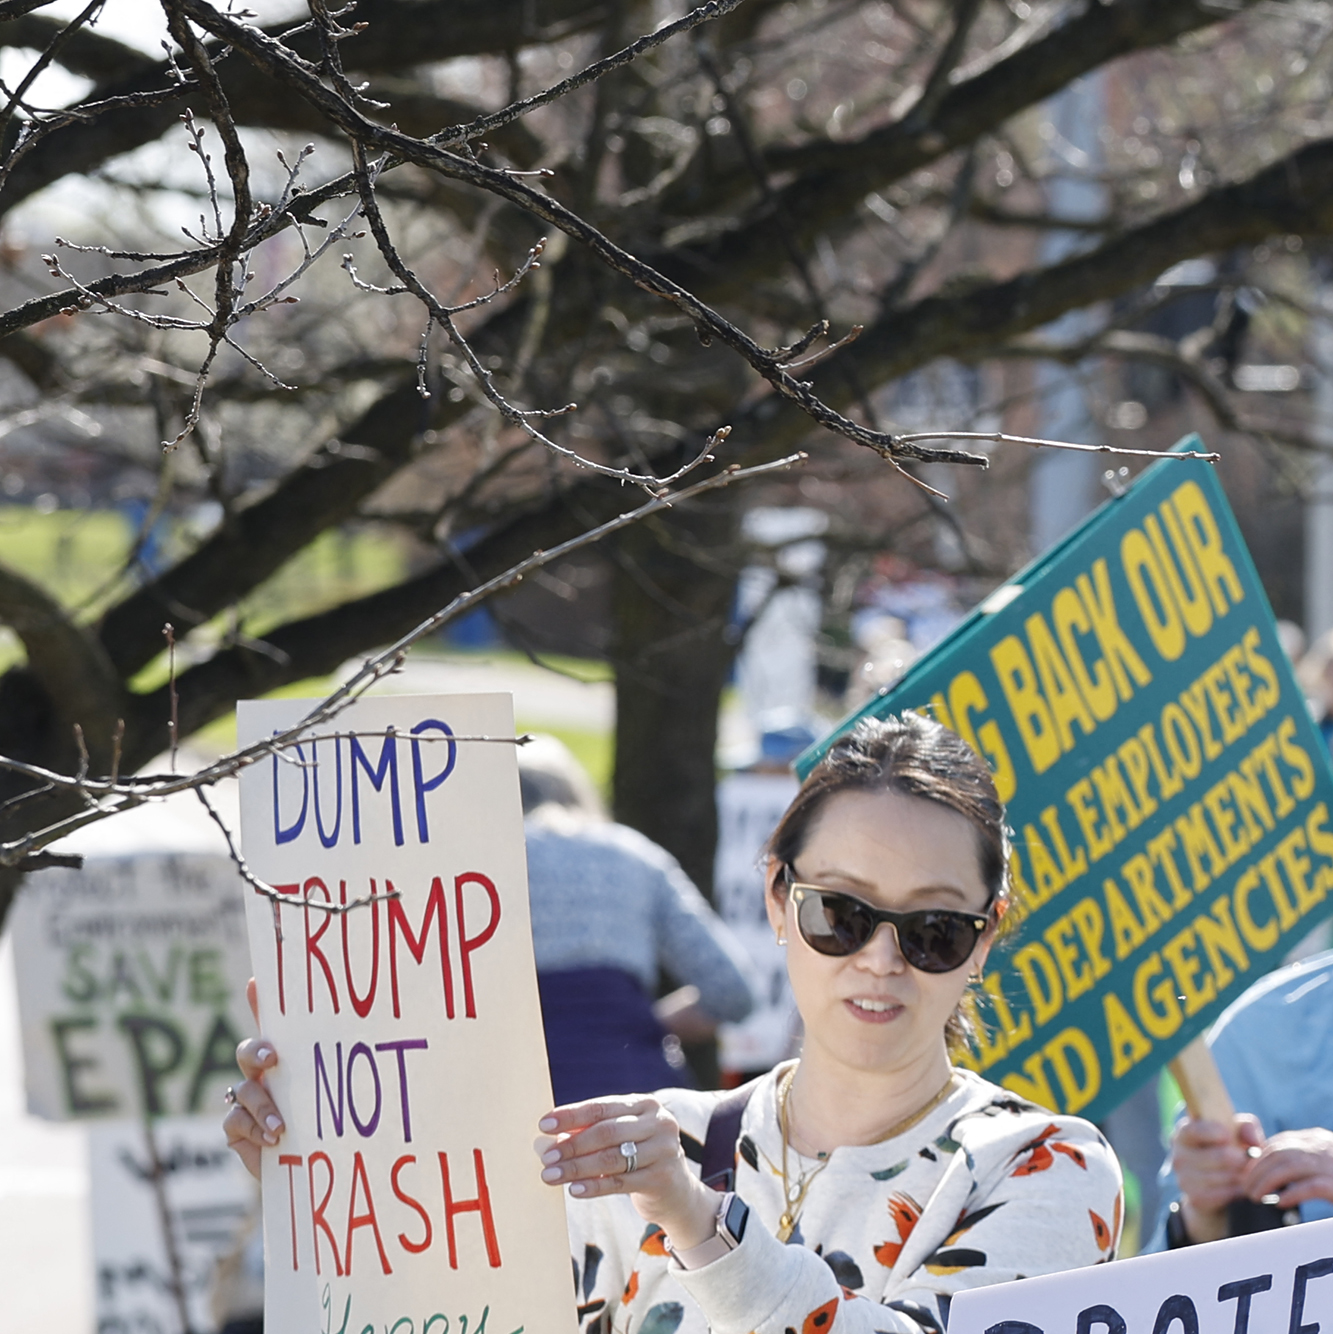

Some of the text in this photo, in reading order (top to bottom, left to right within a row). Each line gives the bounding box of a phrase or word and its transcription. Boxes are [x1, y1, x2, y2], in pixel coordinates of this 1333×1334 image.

[989, 558, 1152, 775] BACK
[1120, 480, 1245, 662] OUR
[272, 718, 457, 849] DUMP
[1065, 626, 1281, 863] EMPLOYEES
[1012, 715, 1316, 1027] DEPARTMENTS
[62, 938, 230, 1004] SAVE
[255, 871, 502, 1019] TRUMP
[48, 1010, 243, 1116] EPA
[313, 1037, 429, 1143] NOT
[1001, 1026, 1101, 1115] ND
[278, 1147, 502, 1277] TRASH
